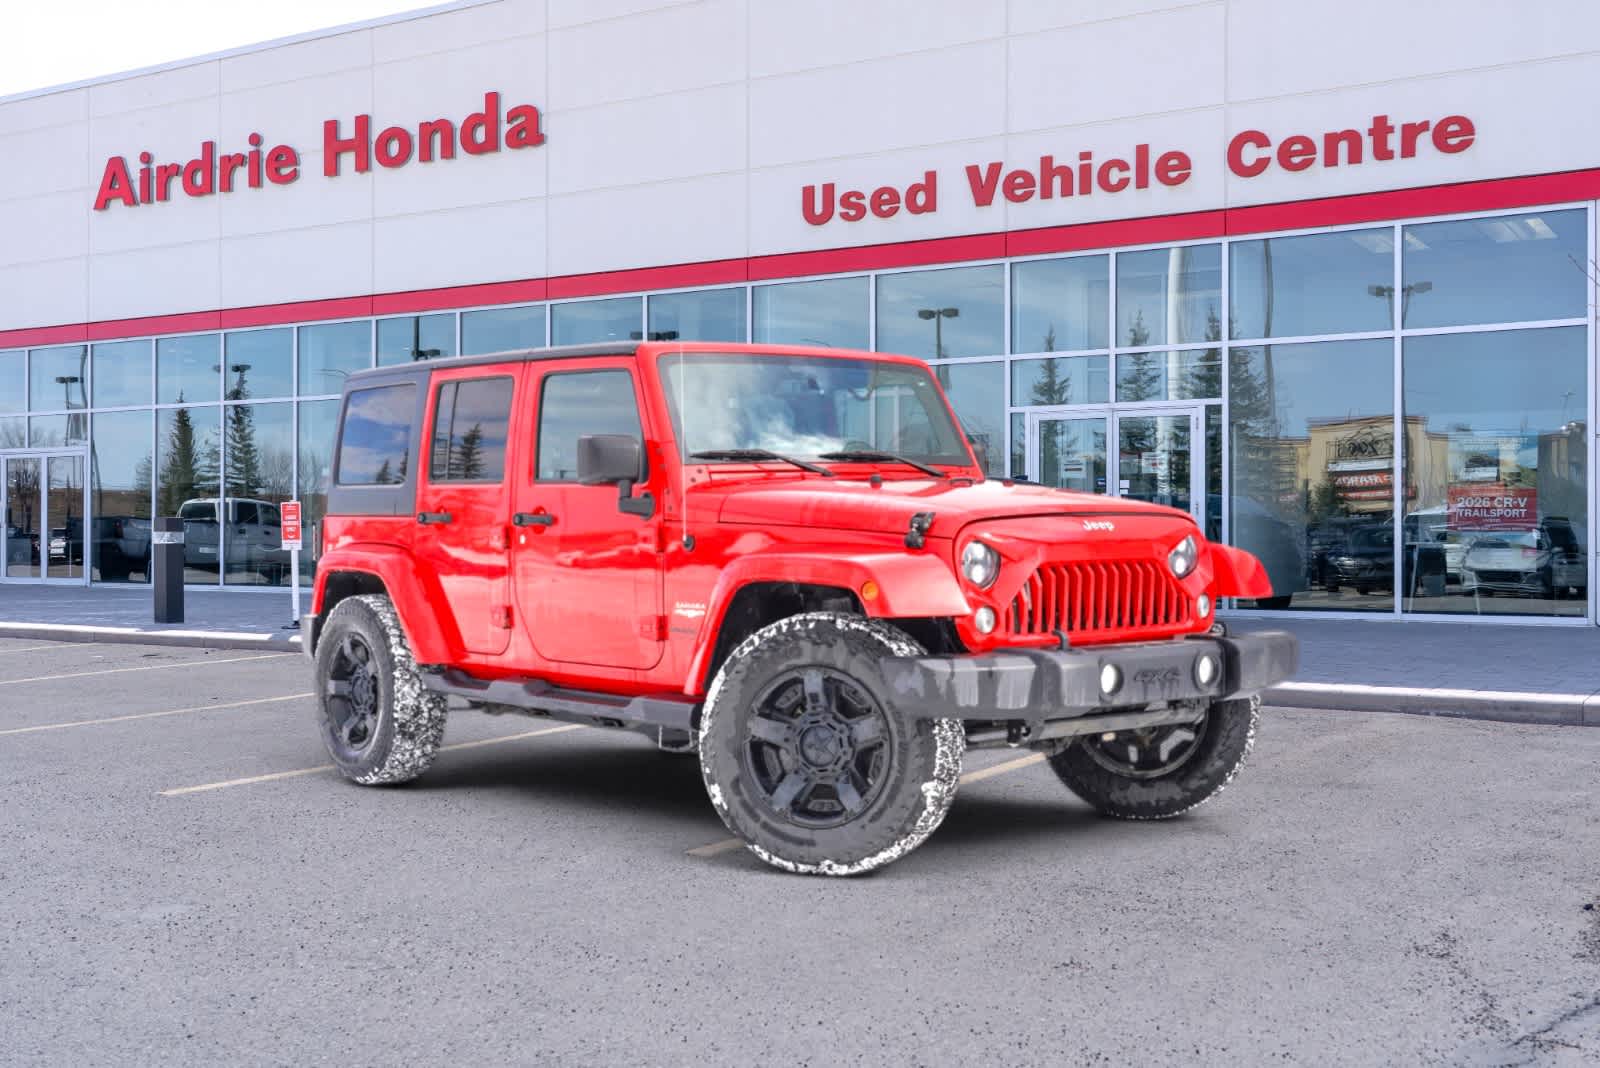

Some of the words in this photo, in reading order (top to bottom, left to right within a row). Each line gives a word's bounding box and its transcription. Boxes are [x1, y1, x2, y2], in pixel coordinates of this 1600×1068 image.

[95, 133, 297, 209] Airdrie
[324, 92, 544, 176] Honda
[803, 171, 936, 224] Used
[966, 144, 1191, 205] Vehicle
[1228, 116, 1475, 176] Centre
[1457, 497, 1490, 508] 2026
[1494, 497, 1528, 508] CR-V
[1458, 508, 1528, 518] TRAILSPORT
[1083, 520, 1114, 531] Jeep
